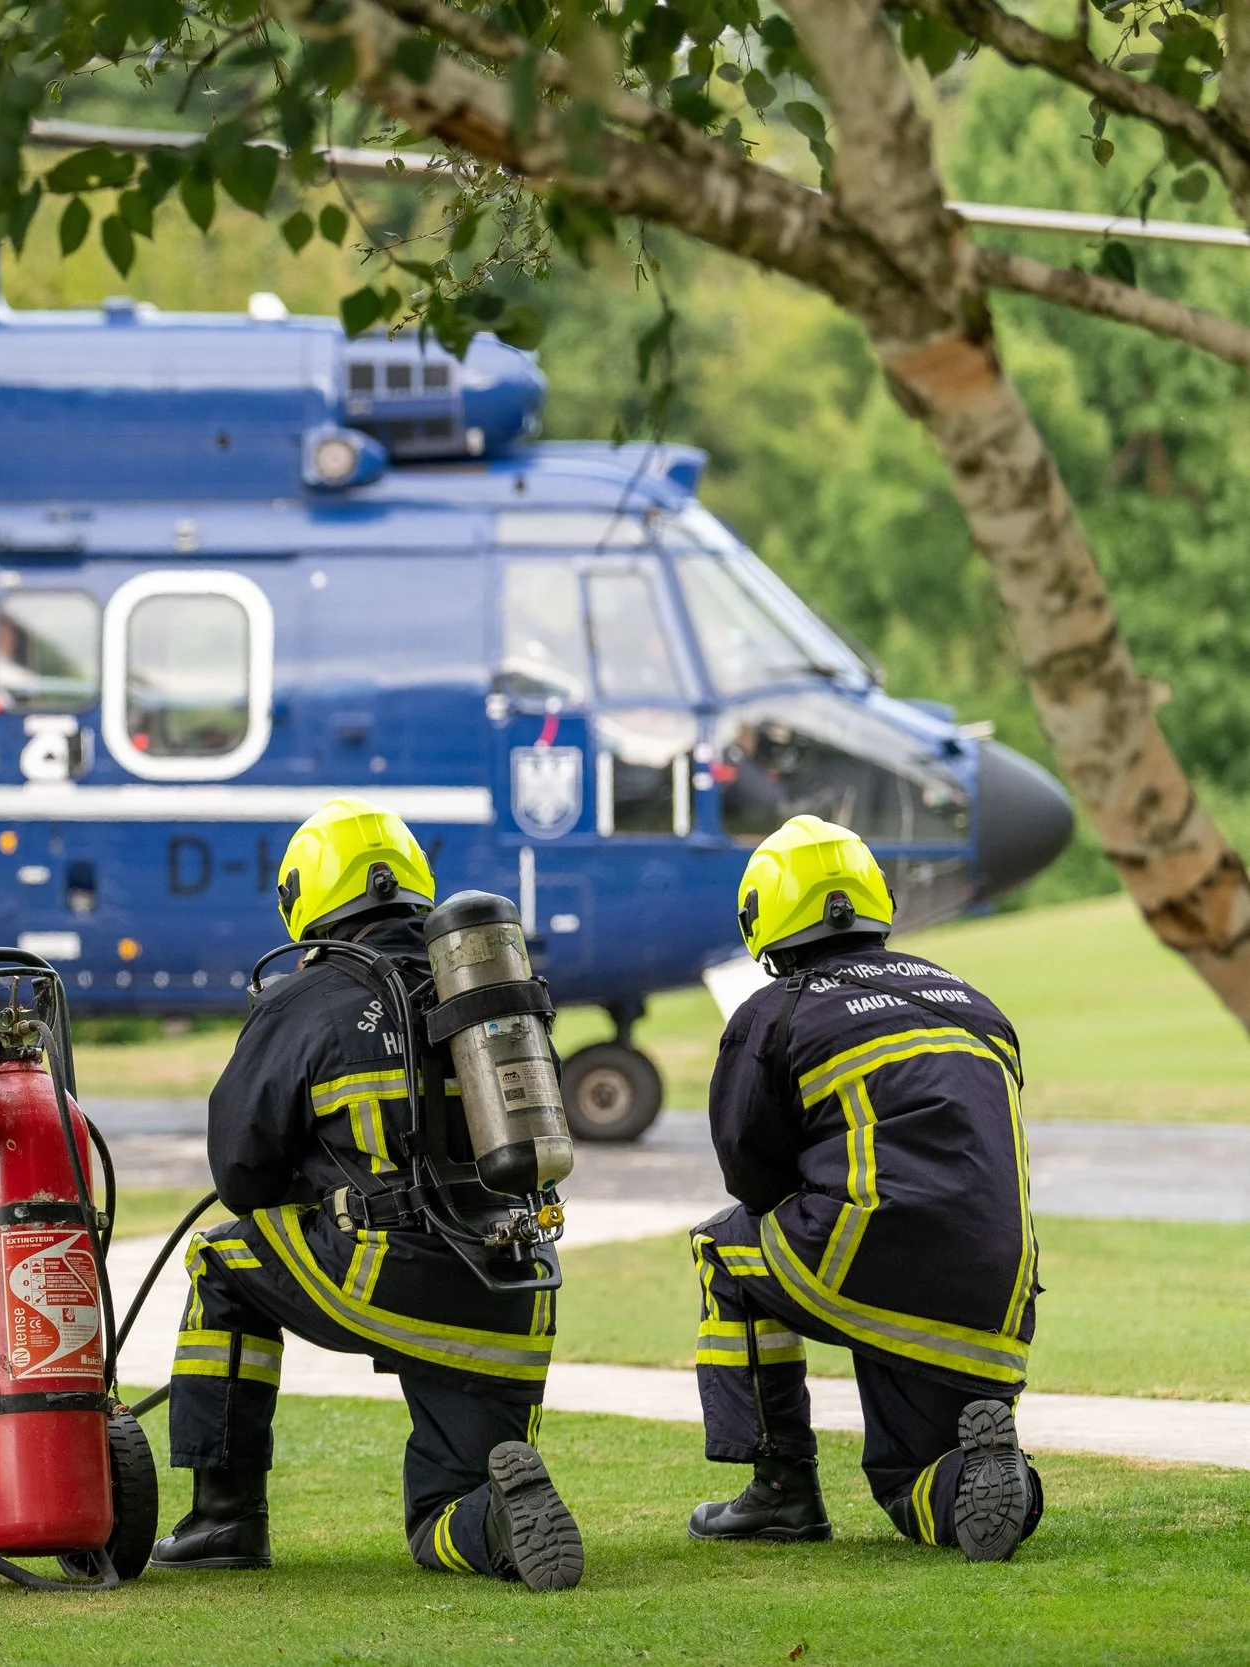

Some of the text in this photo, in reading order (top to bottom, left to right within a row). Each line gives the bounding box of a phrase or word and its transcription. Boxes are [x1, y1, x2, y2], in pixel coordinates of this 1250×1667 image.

[357, 1000, 385, 1033] SAP
[6, 1236, 54, 1245] EXTINCTEUR
[29, 1319, 41, 1329] CE
